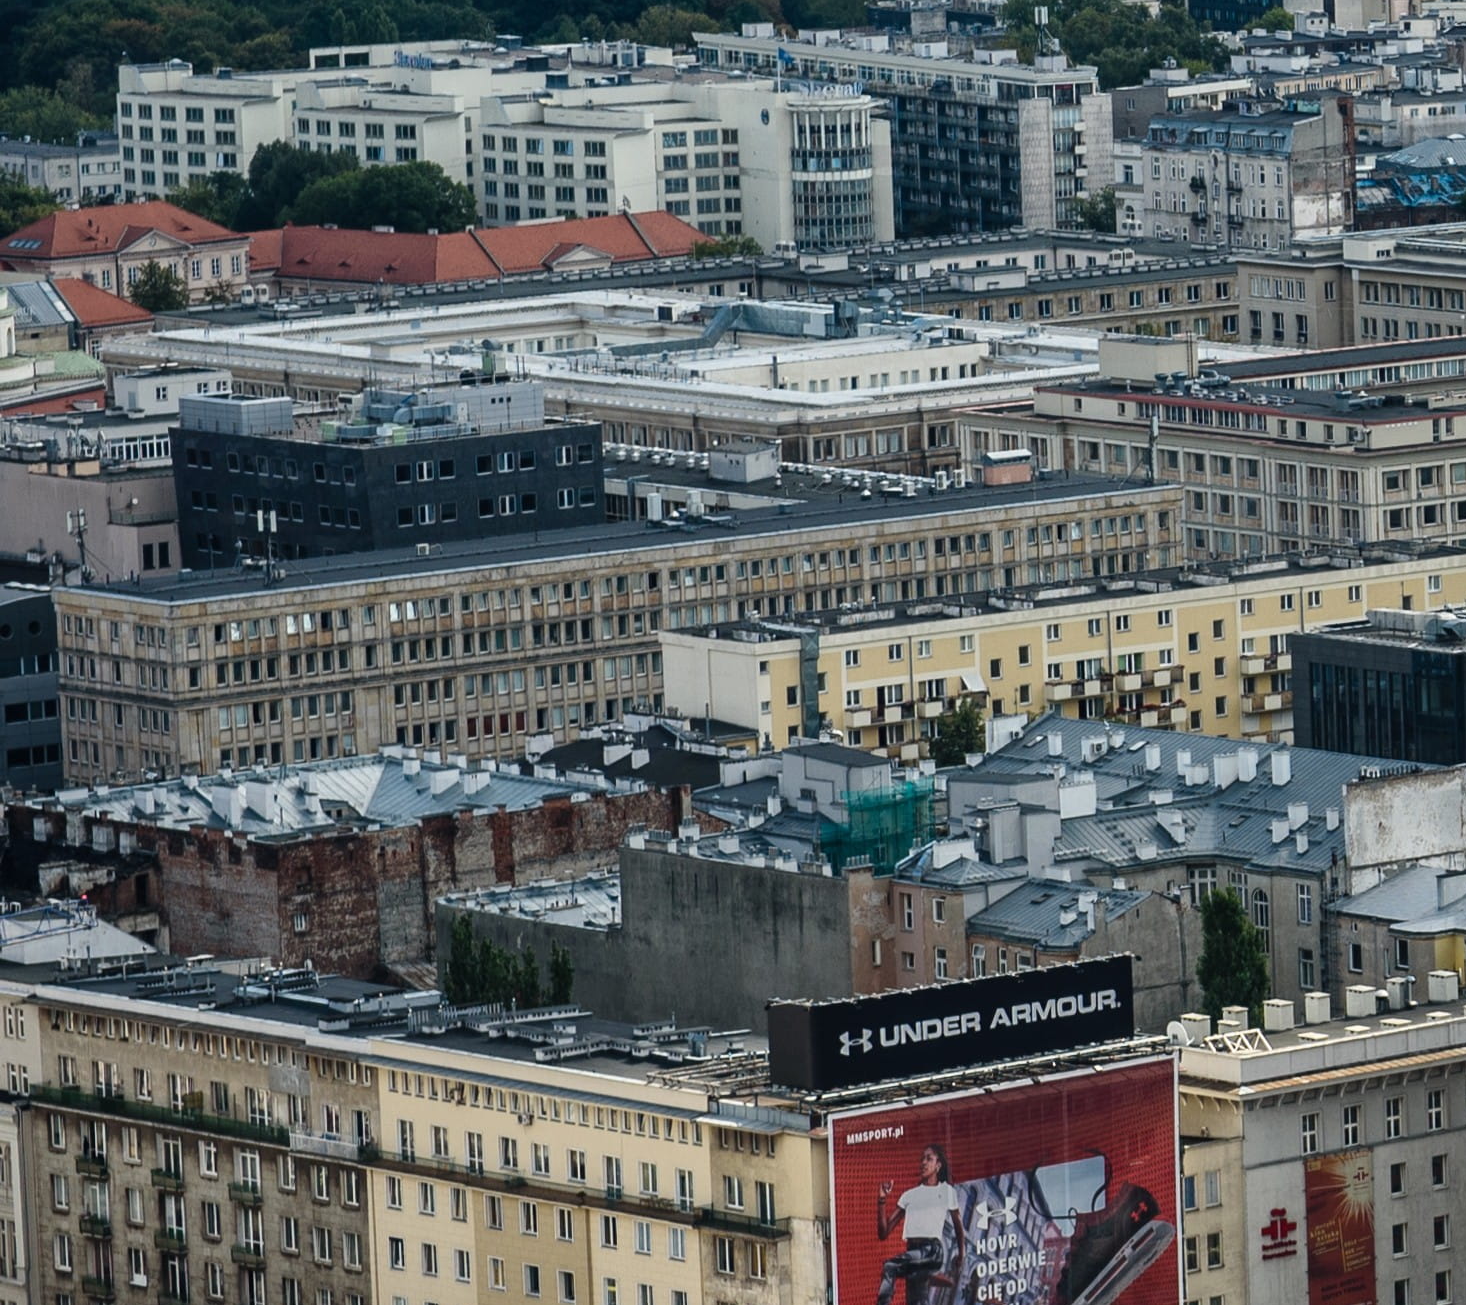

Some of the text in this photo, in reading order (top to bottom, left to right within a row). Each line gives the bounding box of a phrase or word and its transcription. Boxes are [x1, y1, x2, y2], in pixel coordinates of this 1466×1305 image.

[879, 1010, 982, 1048] UNDER
[846, 1124, 904, 1145] MMSPORT.pl
[976, 1233, 1017, 1256] HOVR
[976, 1250, 1046, 1279] ODERWIE
[977, 1278, 1028, 1302] CIĘ OD
